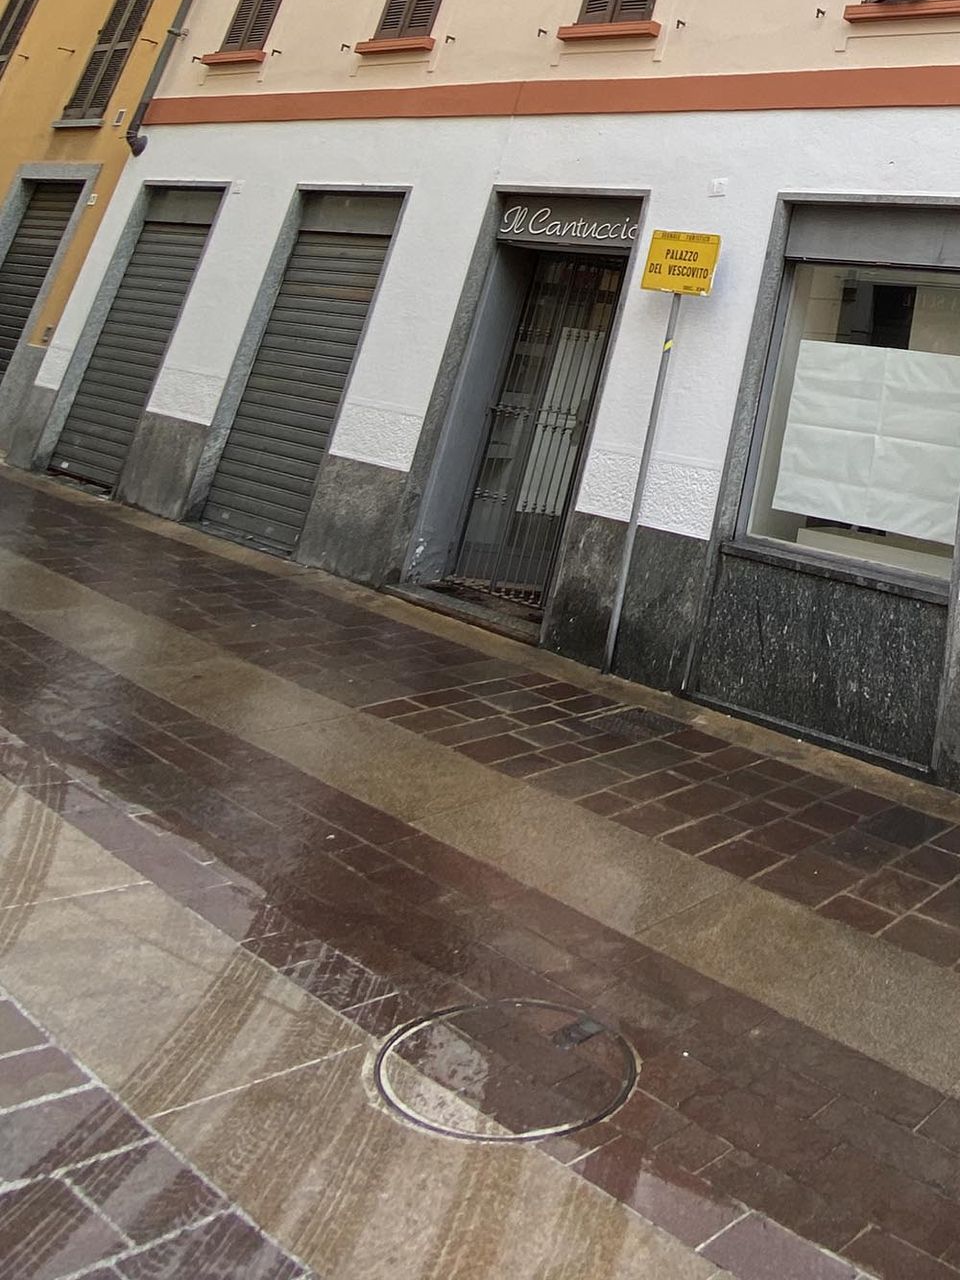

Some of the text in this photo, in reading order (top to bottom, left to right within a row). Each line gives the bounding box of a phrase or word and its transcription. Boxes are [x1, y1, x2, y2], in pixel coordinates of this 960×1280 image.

[500, 206, 528, 233] Il
[665, 248, 699, 262] PALAZZO
[648, 262, 709, 279] DEL VESCOVITO
